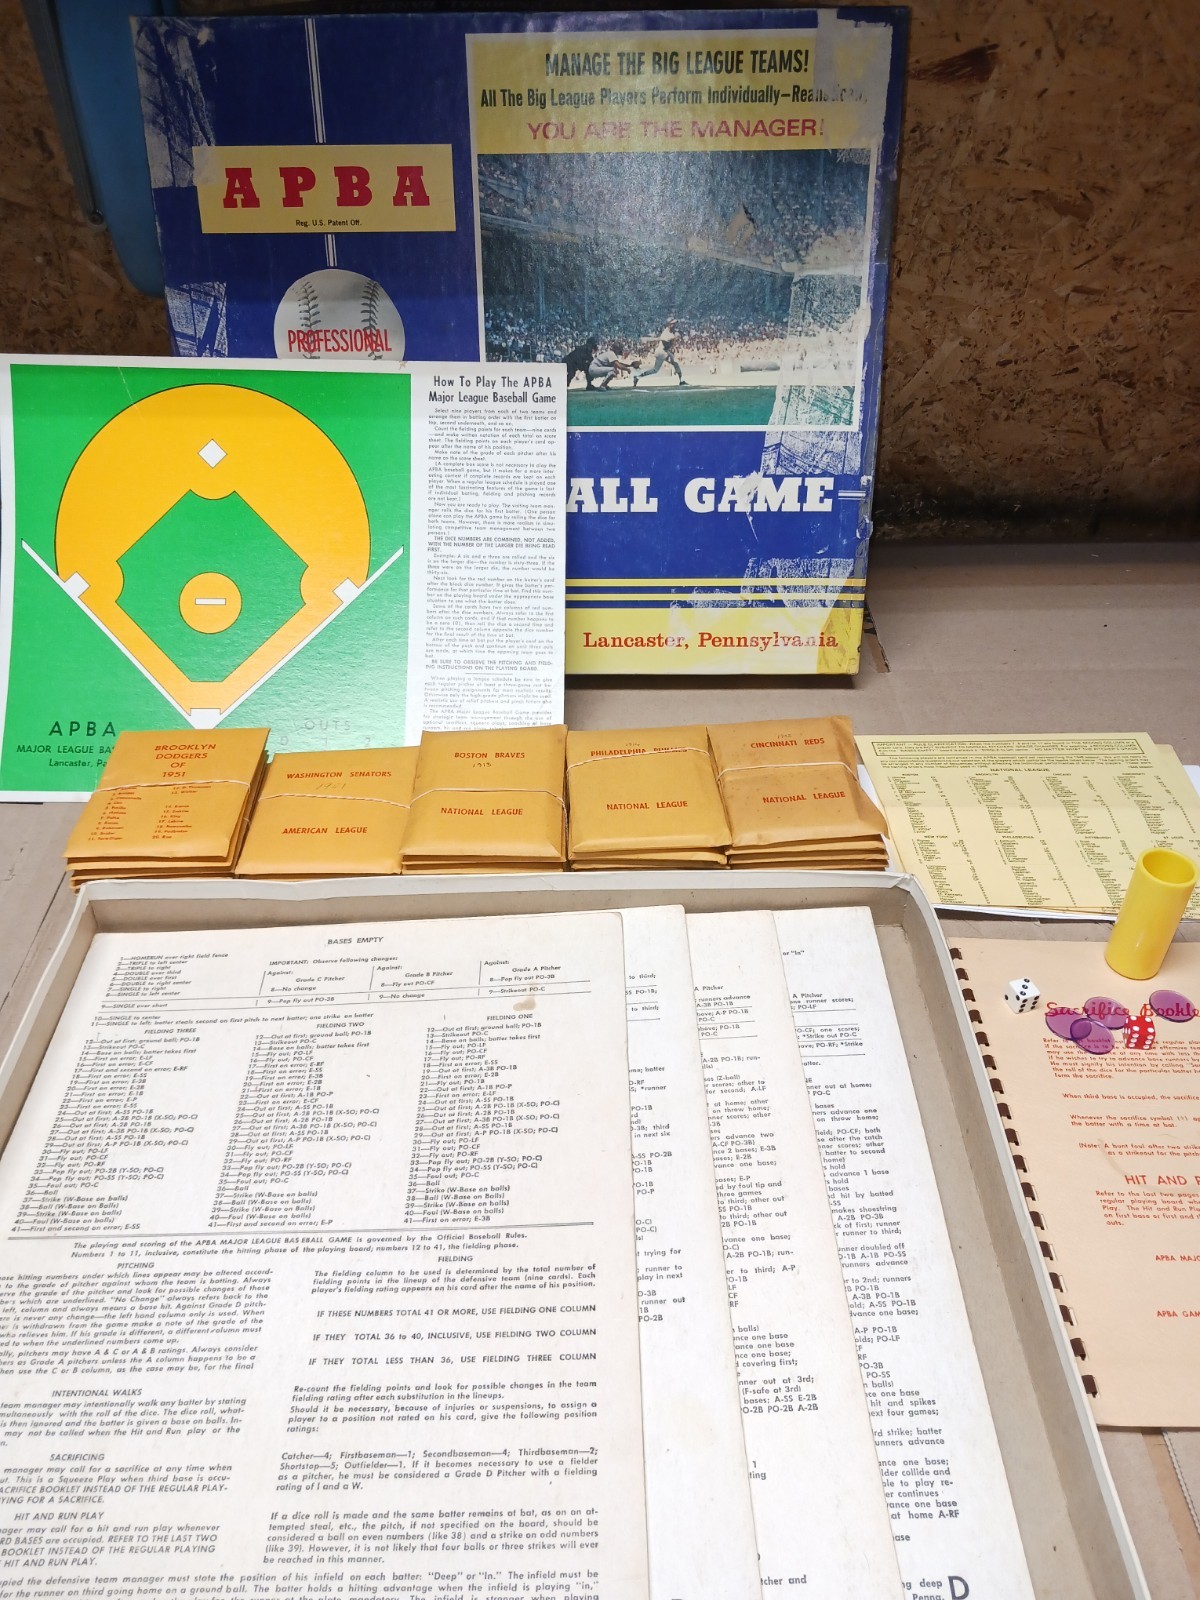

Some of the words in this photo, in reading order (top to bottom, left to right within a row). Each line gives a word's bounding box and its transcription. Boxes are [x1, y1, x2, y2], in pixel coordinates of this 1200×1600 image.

[545, 52, 612, 76] MANAGE
[617, 52, 645, 75] THE
[653, 51, 679, 75] BIG
[686, 51, 743, 74] LEAGUE
[750, 49, 809, 73] TEAMS!
[481, 90, 496, 107] All
[500, 89, 522, 106] The
[527, 89, 546, 109] Big
[551, 88, 594, 109] League
[600, 88, 645, 108] Players
[651, 87, 701, 105] Perform
[527, 122, 574, 141] YOU
[584, 120, 630, 139] ARE
[642, 120, 682, 138] THE
[692, 119, 824, 137] MANAGER!
[223, 166, 430, 208] APBA
[288, 329, 391, 352] PROFESSIONAL
[434, 376, 454, 386] How
[460, 376, 471, 387] To
[476, 376, 496, 389] Play
[501, 376, 518, 387] The
[523, 377, 552, 388] APBA
[429, 391, 454, 403] Major
[459, 392, 488, 404] League
[493, 392, 527, 403] Baseball
[532, 392, 556, 403] Game
[684, 477, 834, 512] GAME
[584, 633, 689, 650] Lancaster,
[698, 632, 838, 650] Pennsylvania
[49, 721, 115, 736] APBA
[305, 720, 350, 730] OUTS
[17, 745, 51, 753] MAJOR
[751, 740, 797, 748] CINCINNATI
[156, 752, 207, 760] DODGERS
[49, 759, 93, 767] Lancaster,
[763, 795, 806, 803] NATIONAL
[813, 791, 845, 799] LEAGUE
[606, 802, 649, 811] NATIONAL
[657, 801, 688, 810] LEAGUE
[282, 827, 327, 835] AMERICAN
[335, 826, 367, 834] LEAGUE
[1045, 1002, 1129, 1020] Sacrifice
[1125, 1175, 1147, 1185] HIT
[1157, 1176, 1187, 1185] AND
[438, 1255, 473, 1263] FIELDING
[396, 1308, 421, 1316] TOTAL
[452, 1307, 478, 1315] MORE,
[500, 1306, 536, 1314] FIELDING
[539, 1305, 557, 1313] ONE
[313, 1333, 321, 1341] IF
[324, 1333, 346, 1341] THEY
[384, 1332, 395, 1340] 36
[398, 1332, 407, 1340] to
[427, 1331, 472, 1339] INCLUSIVE,
[476, 1330, 491, 1338] USE
[495, 1330, 532, 1338] FIELDING
[536, 1329, 556, 1337] TWO
[386, 1356, 404, 1364] LESS
[441, 1355, 454, 1363] 36,
[482, 1354, 520, 1362] FIELDING
[50, 1453, 105, 1461] SACRIFICING
[281, 1452, 333, 1461] Catcher—4;
[340, 1451, 416, 1460] Firstbaseman—1;
[423, 1450, 511, 1459] Secondbaseman—4;
[518, 1448, 598, 1456] Thirdbaseman—2;
[14, 1513, 29, 1521] HIT
[33, 1512, 54, 1520] AND
[58, 1512, 77, 1520] RUN
[80, 1512, 104, 1520] PLAY
[891, 1511, 901, 1519] at
[908, 1511, 933, 1519] home
[938, 1509, 960, 1519] A-RF
[919, 1578, 942, 1589] deep
[948, 1575, 970, 1600] D
